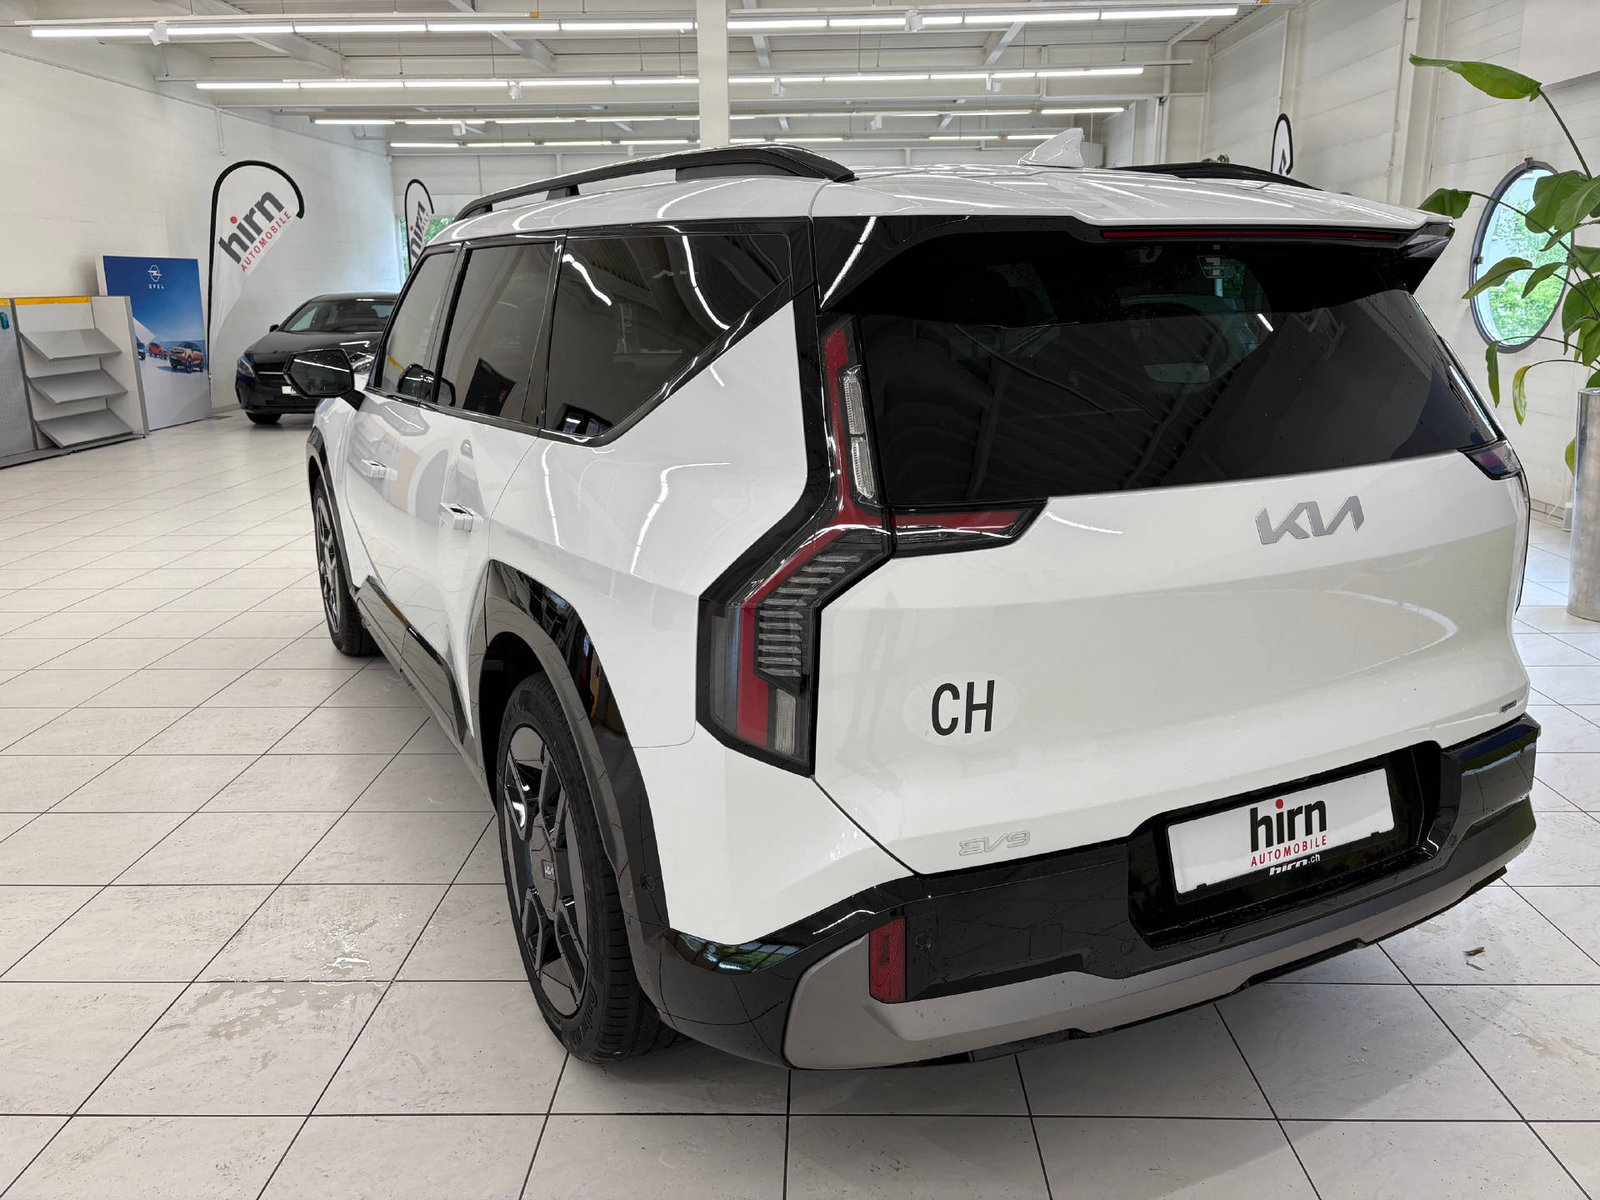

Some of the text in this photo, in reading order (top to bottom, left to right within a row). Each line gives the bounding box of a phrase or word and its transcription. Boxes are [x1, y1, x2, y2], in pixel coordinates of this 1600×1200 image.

[218, 191, 285, 264] hirn
[240, 210, 291, 272] AUTOMOBILE
[1255, 495, 1365, 545] KIA
[931, 679, 995, 736] CH
[959, 830, 1031, 856] EV9
[1250, 798, 1327, 853] hirn
[1250, 834, 1327, 868] AUTOMOBILE
[1269, 853, 1321, 876] hirn.ch
